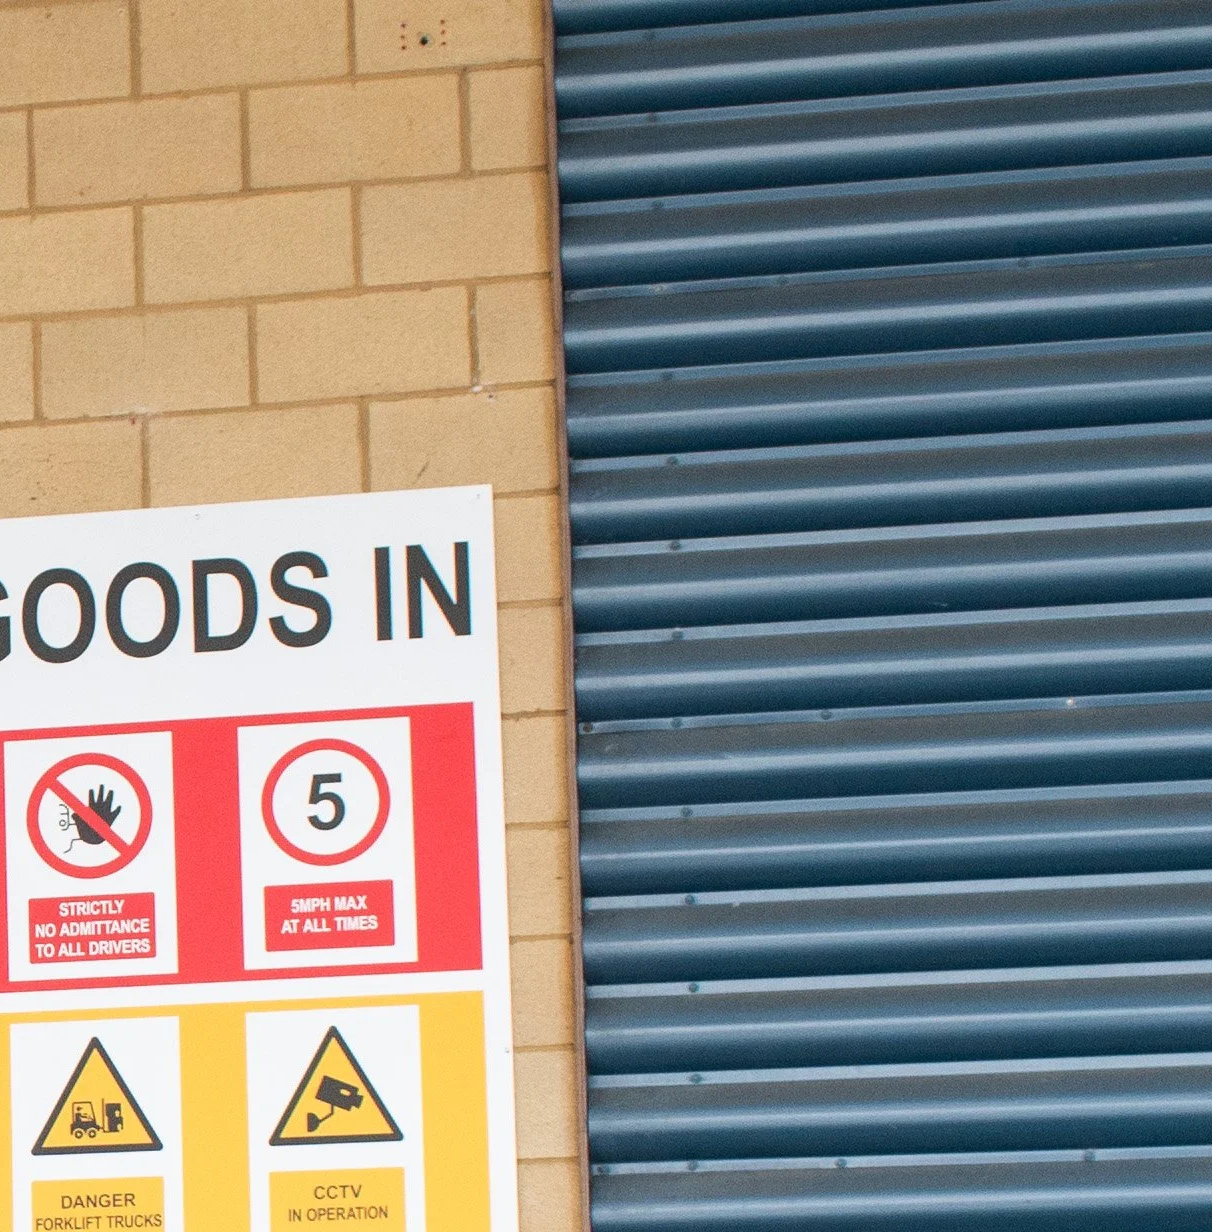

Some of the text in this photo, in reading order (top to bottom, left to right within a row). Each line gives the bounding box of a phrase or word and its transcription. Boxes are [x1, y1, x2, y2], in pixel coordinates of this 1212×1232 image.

[374, 540, 473, 641] IN
[307, 772, 346, 831] 5
[59, 899, 125, 917] STRICTLY
[291, 895, 368, 913] 5MPH MAX
[35, 918, 150, 938] NO ADMITTANCE
[281, 915, 378, 934] AT ALL TIMES
[35, 938, 151, 958] TO ALL DRIVERS
[313, 1184, 362, 1199] CCTV
[61, 1193, 136, 1209] DANGER
[35, 1213, 163, 1231] FORKLIFT TRUCKS
[288, 1205, 388, 1222] IN OPERATION
